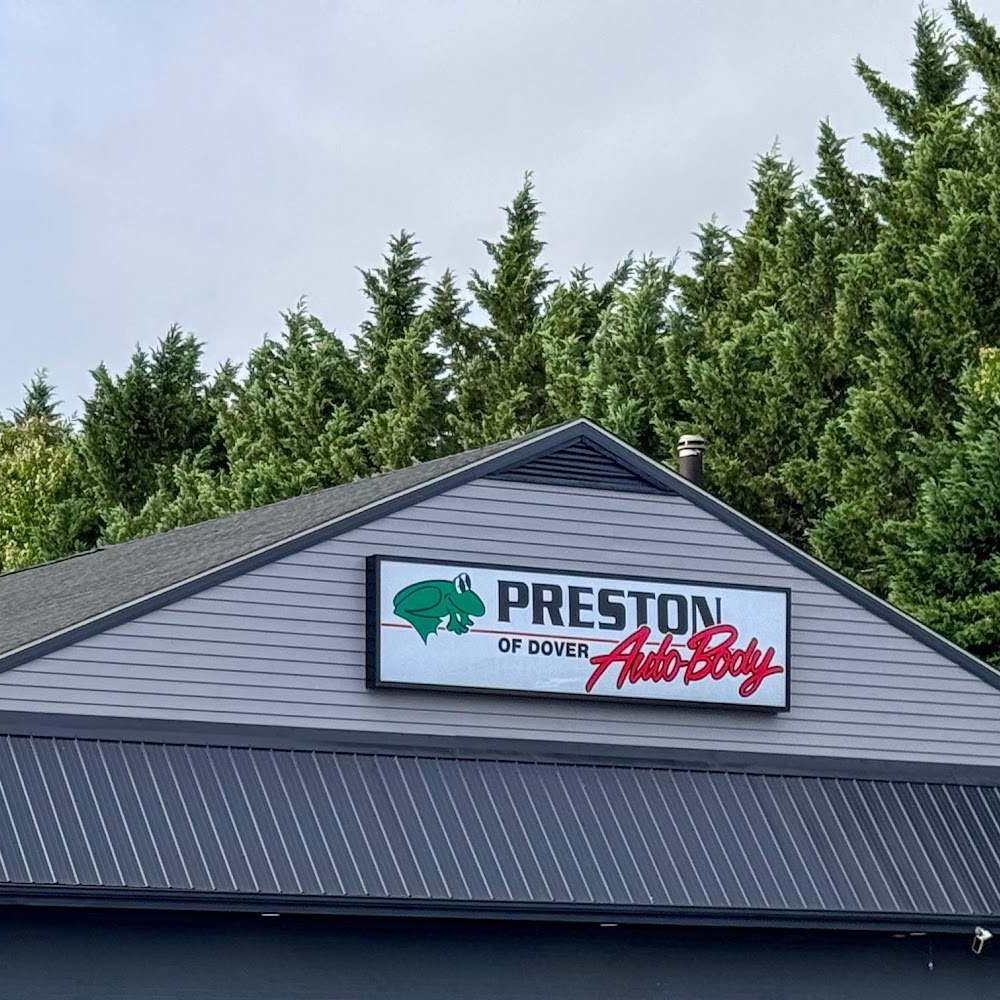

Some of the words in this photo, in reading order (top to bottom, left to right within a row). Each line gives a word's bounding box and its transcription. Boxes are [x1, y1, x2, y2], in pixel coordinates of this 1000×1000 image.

[497, 581, 722, 635] PRESTON
[498, 637, 523, 654] OF
[528, 641, 590, 659] DOVER
[585, 624, 784, 697] Auto-Body
